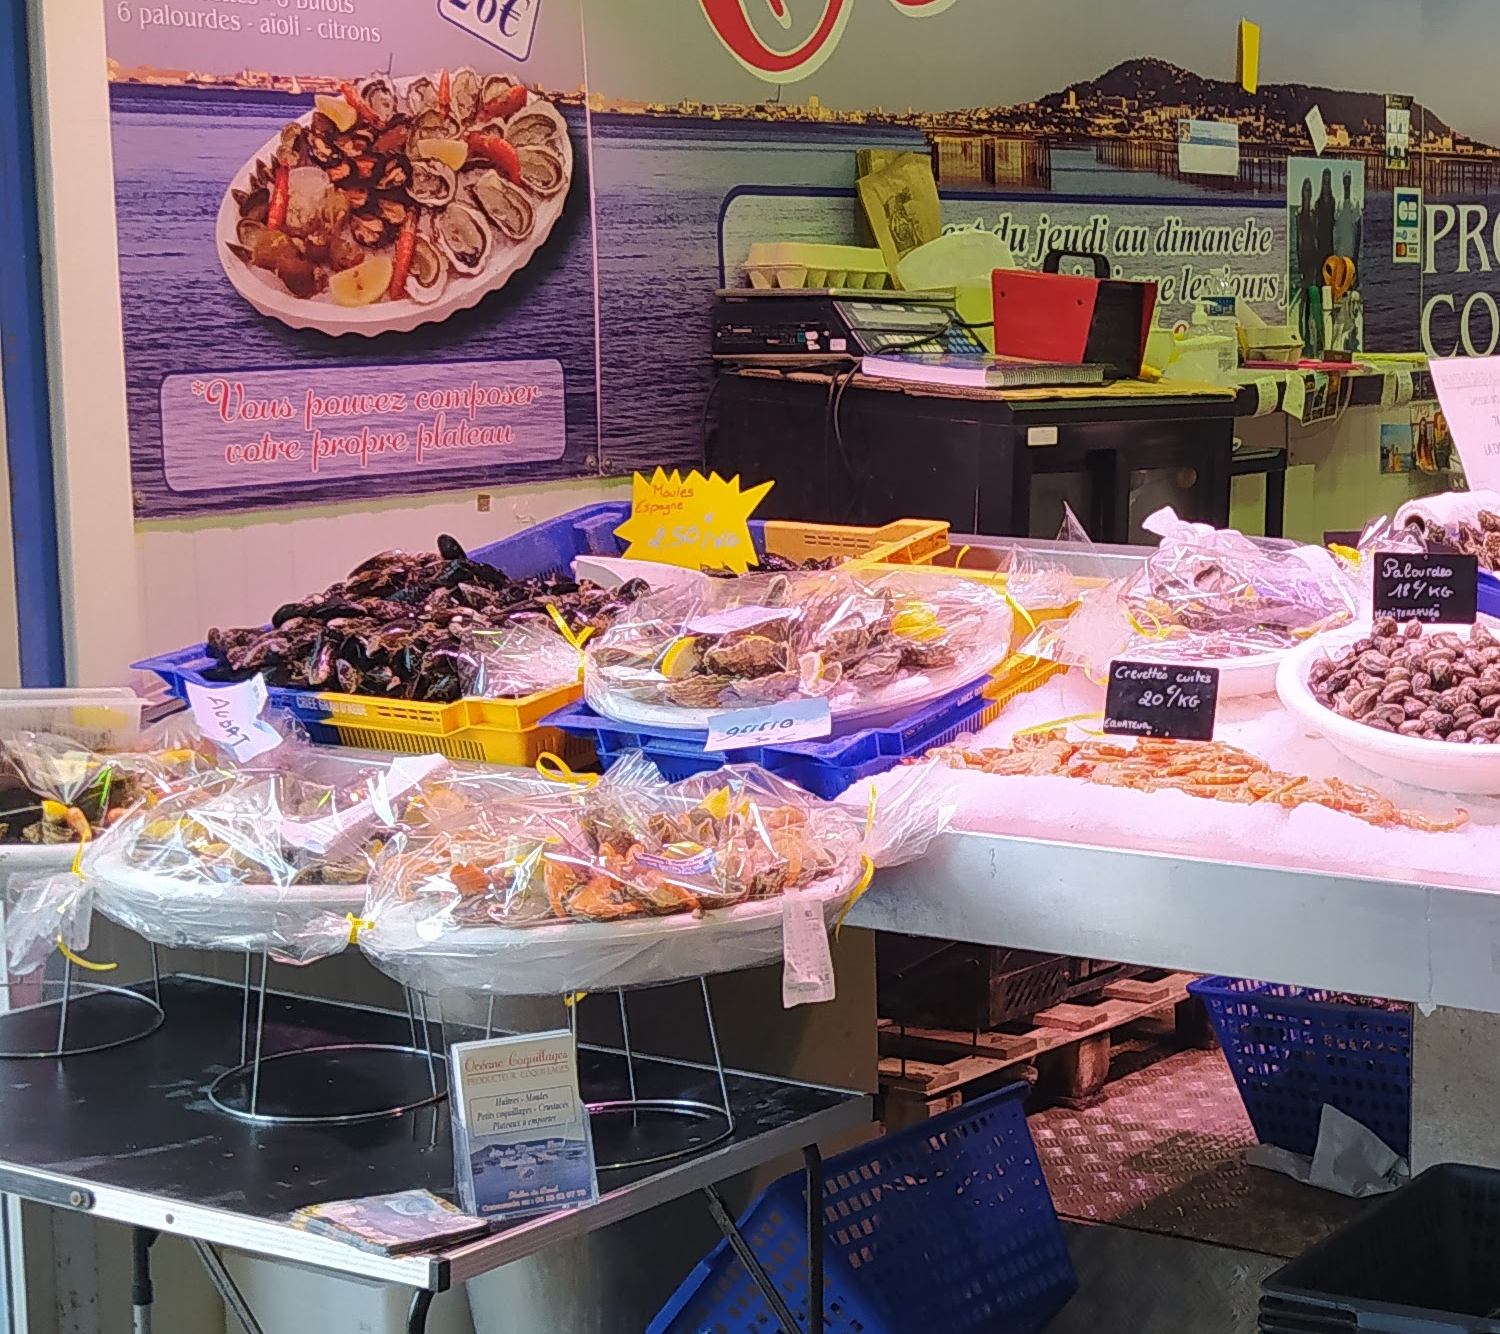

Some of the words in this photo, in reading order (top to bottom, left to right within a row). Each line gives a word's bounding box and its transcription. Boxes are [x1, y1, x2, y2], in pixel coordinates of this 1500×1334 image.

[117, 2, 132, 23] 6
[139, 5, 241, 32] palourdes
[317, 20, 382, 44] citrons
[1031, 214, 1109, 265] jeudi
[1113, 227, 1149, 254] au
[1155, 217, 1274, 255] dimanche
[1222, 264, 1279, 301] ours
[305, 389, 407, 431] pouvez
[415, 379, 542, 420] composer
[224, 428, 303, 465] votre
[312, 425, 408, 471] propre
[416, 412, 516, 462] plateau
[652, 484, 694, 498] Moules
[635, 500, 684, 516] Espagne
[1382, 558, 1453, 578] Palourdes
[1115, 666, 1168, 680] Crevettes
[1176, 670, 1211, 683] cuites
[508, 1049, 568, 1068] Coquillages
